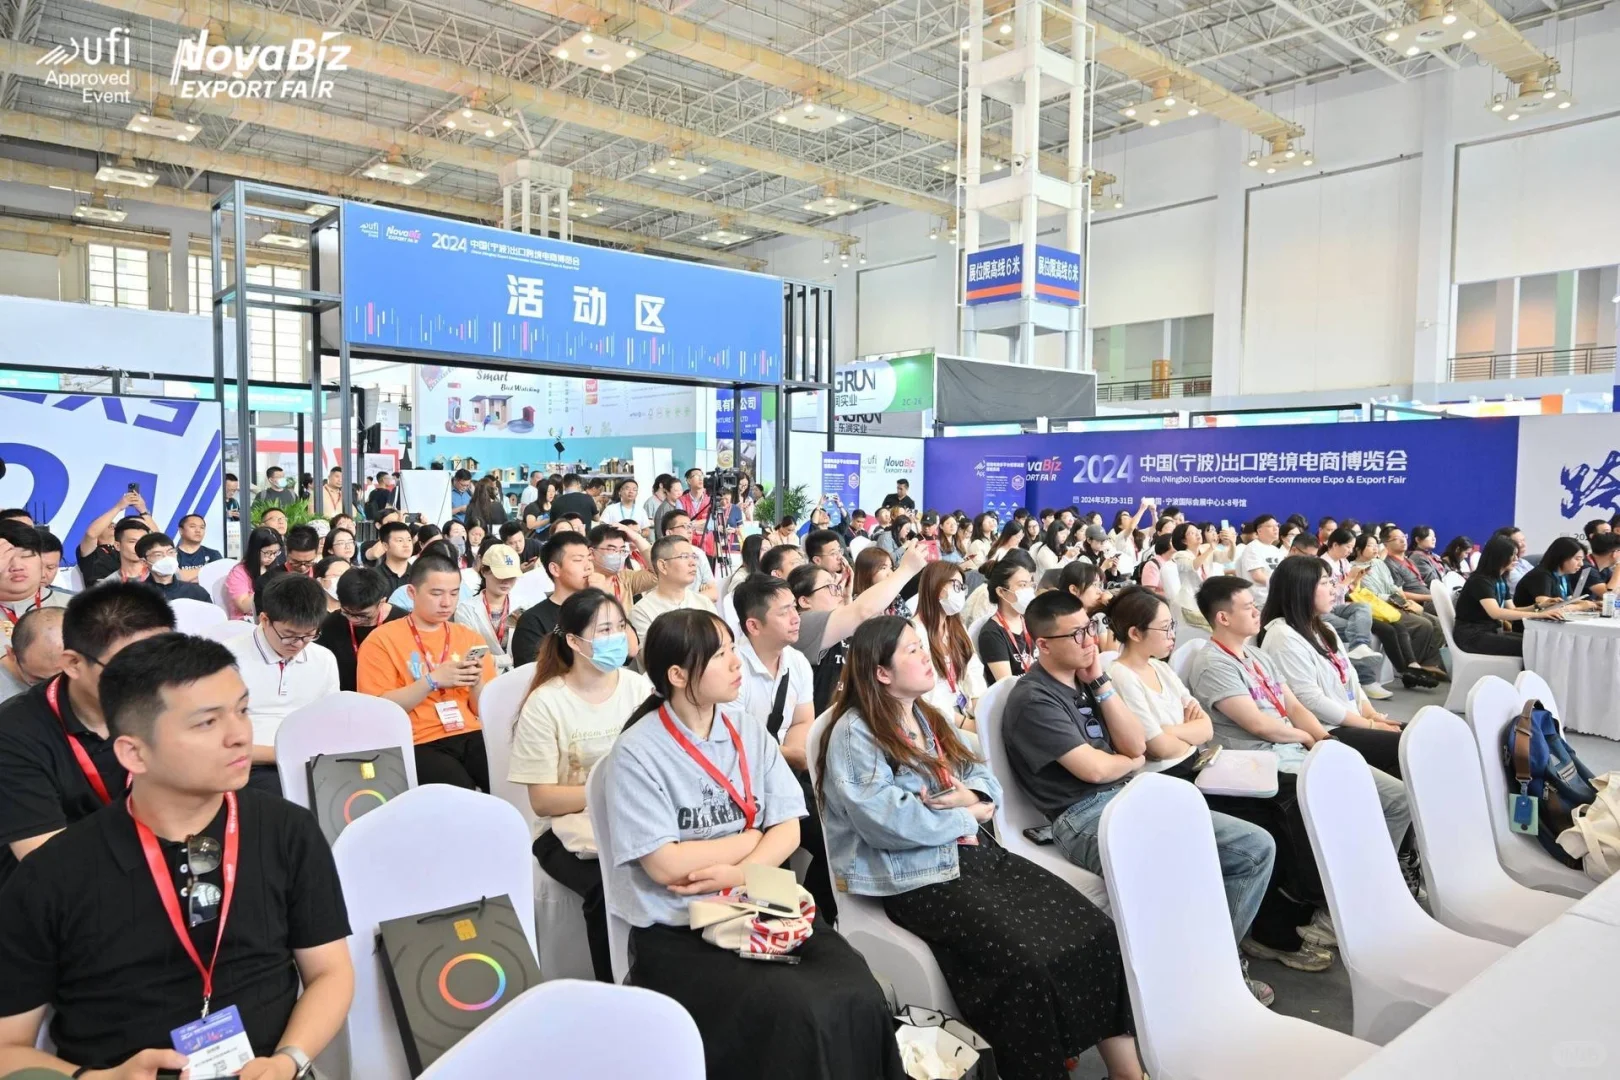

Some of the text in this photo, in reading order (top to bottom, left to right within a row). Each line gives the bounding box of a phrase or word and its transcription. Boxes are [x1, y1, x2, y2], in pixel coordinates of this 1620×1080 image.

[431, 232, 467, 253] 2024
[969, 256, 1021, 282] 展位限高线6米
[1038, 256, 1078, 282] 展位限高线6米
[476, 369, 509, 382] Smart
[834, 368, 876, 393] GRUN
[884, 456, 916, 469] NovaBiz
[1027, 456, 1062, 474] vaBiz
[1072, 454, 1134, 484] 2024
[1140, 450, 1408, 472] 中国(宁波)出口跨境电商博览会
[1141, 475, 1406, 485] China (Ningbo) Export Cross-border E-commerce Expo & Export Fair
[1081, 496, 1133, 505] 2024年5月29-31日
